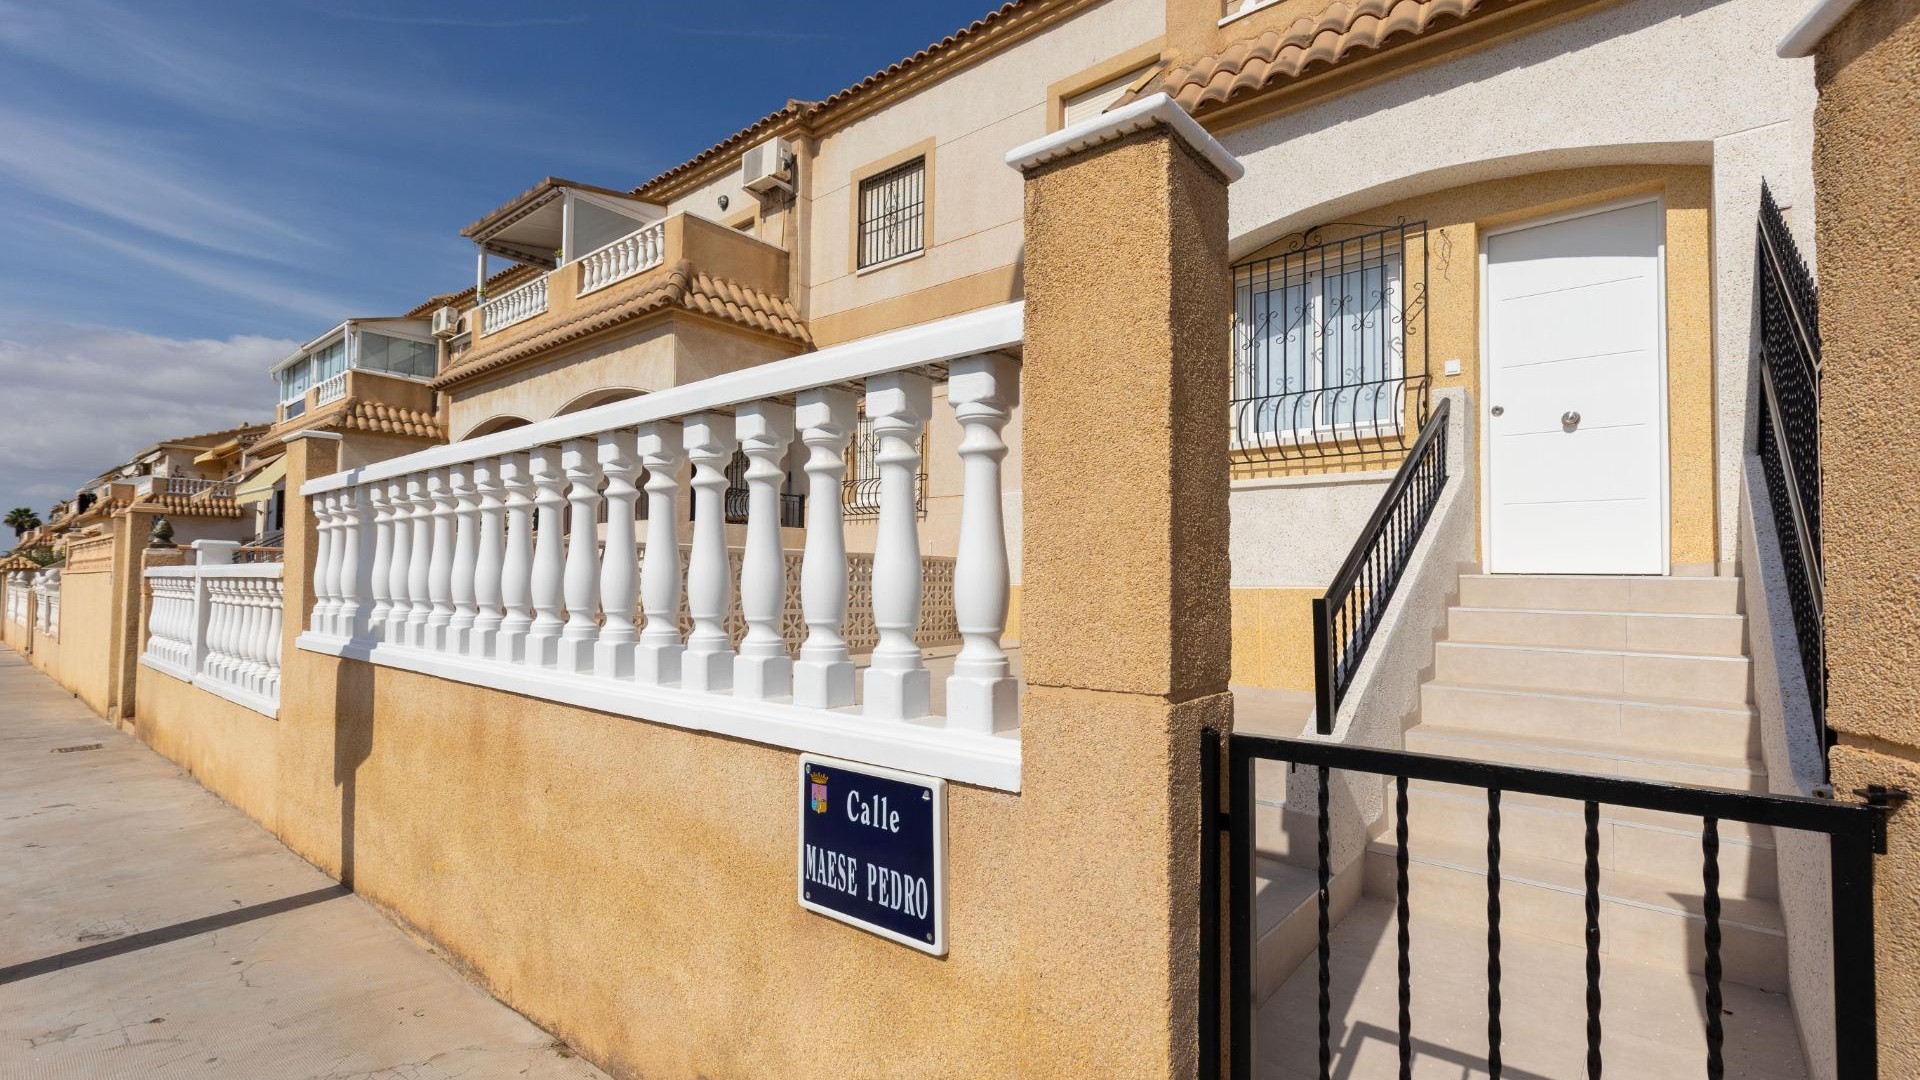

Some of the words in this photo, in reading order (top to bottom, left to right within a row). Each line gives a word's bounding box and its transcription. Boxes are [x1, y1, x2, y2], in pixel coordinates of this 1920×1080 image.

[847, 790, 900, 833] Calle
[805, 844, 858, 896] MAESE
[867, 863, 928, 920] PEDRO
